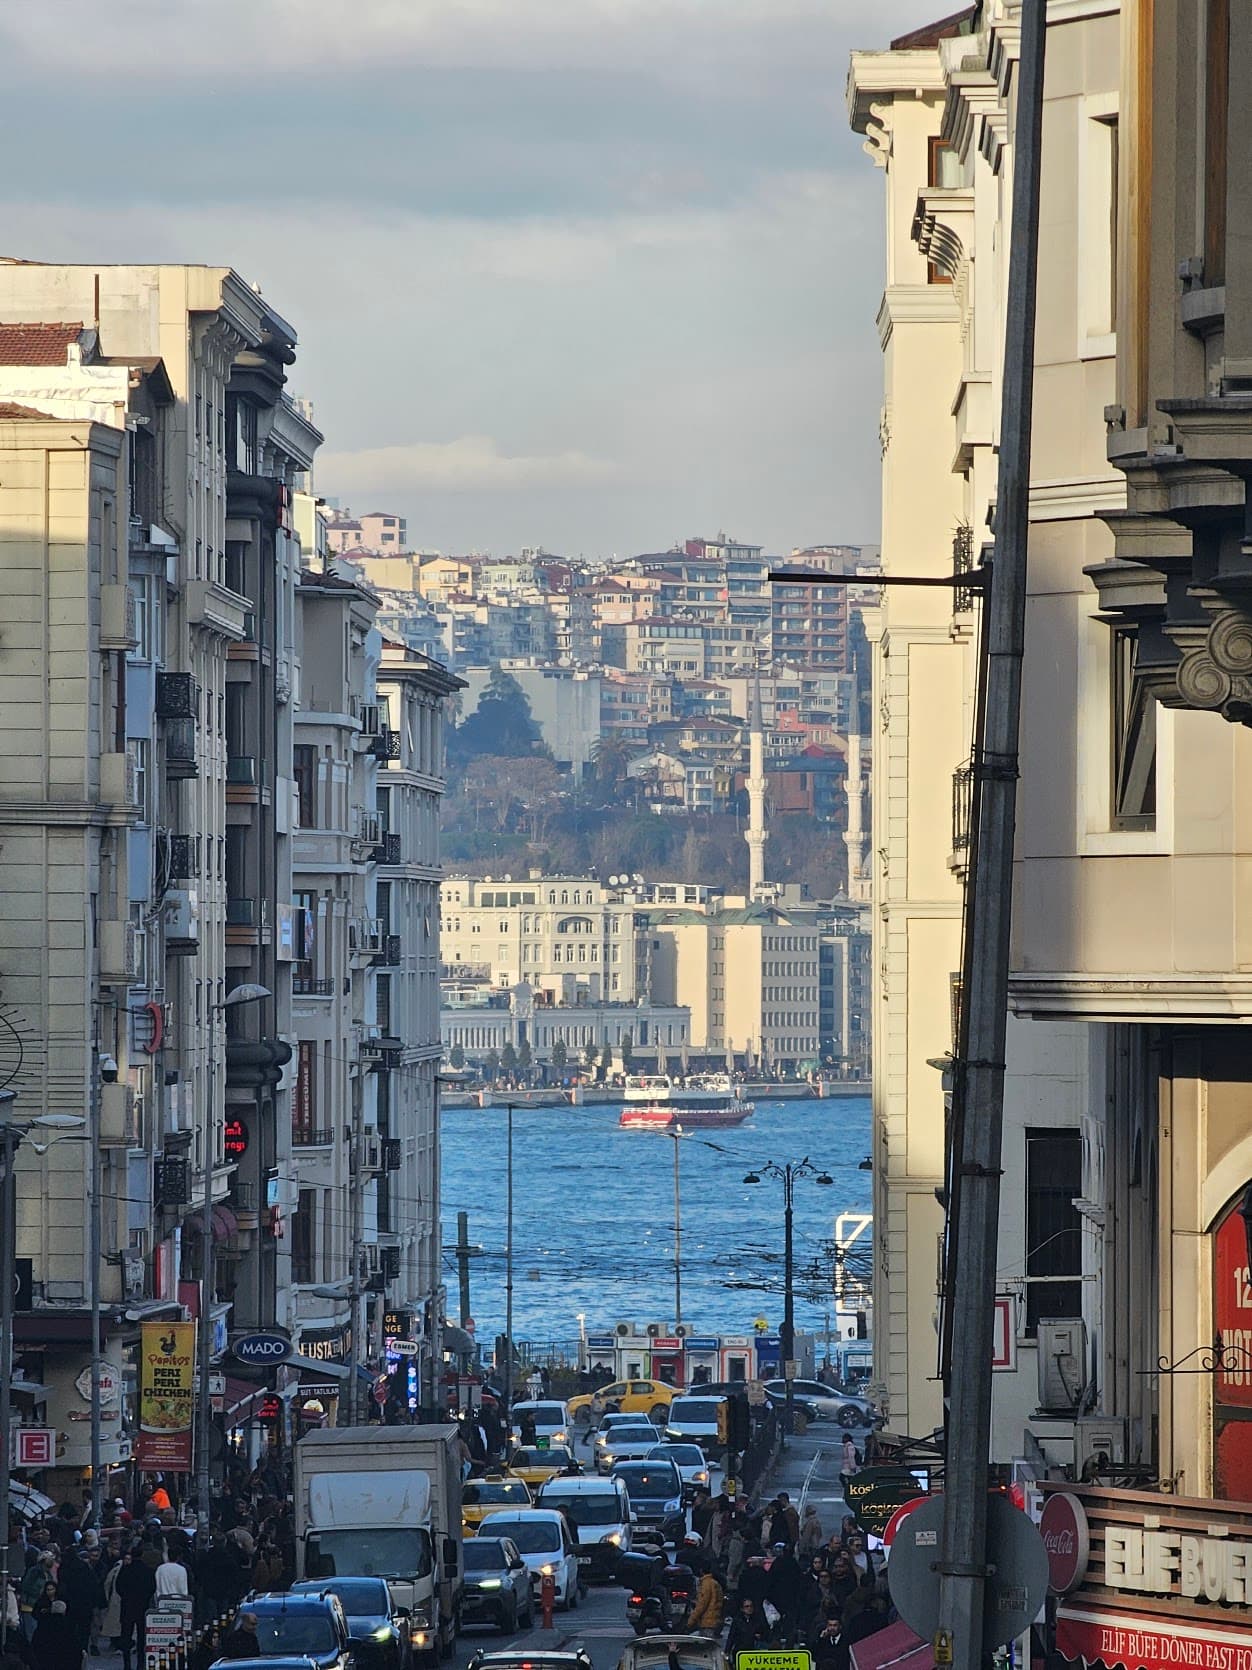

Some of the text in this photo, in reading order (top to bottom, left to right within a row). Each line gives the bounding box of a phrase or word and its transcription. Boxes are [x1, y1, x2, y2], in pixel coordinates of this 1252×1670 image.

[242, 1342, 285, 1355] MADO
[154, 1368, 181, 1377] PERI
[154, 1379, 181, 1387] PERI
[144, 1388, 191, 1398] CHICKEN
[1101, 1628, 1126, 1655] ELİF
[1128, 1631, 1158, 1659] BÜFE
[1160, 1635, 1203, 1665] DÖNER
[1205, 1645, 1235, 1670] FAST
[748, 1656, 799, 1665] YÜKLEME
